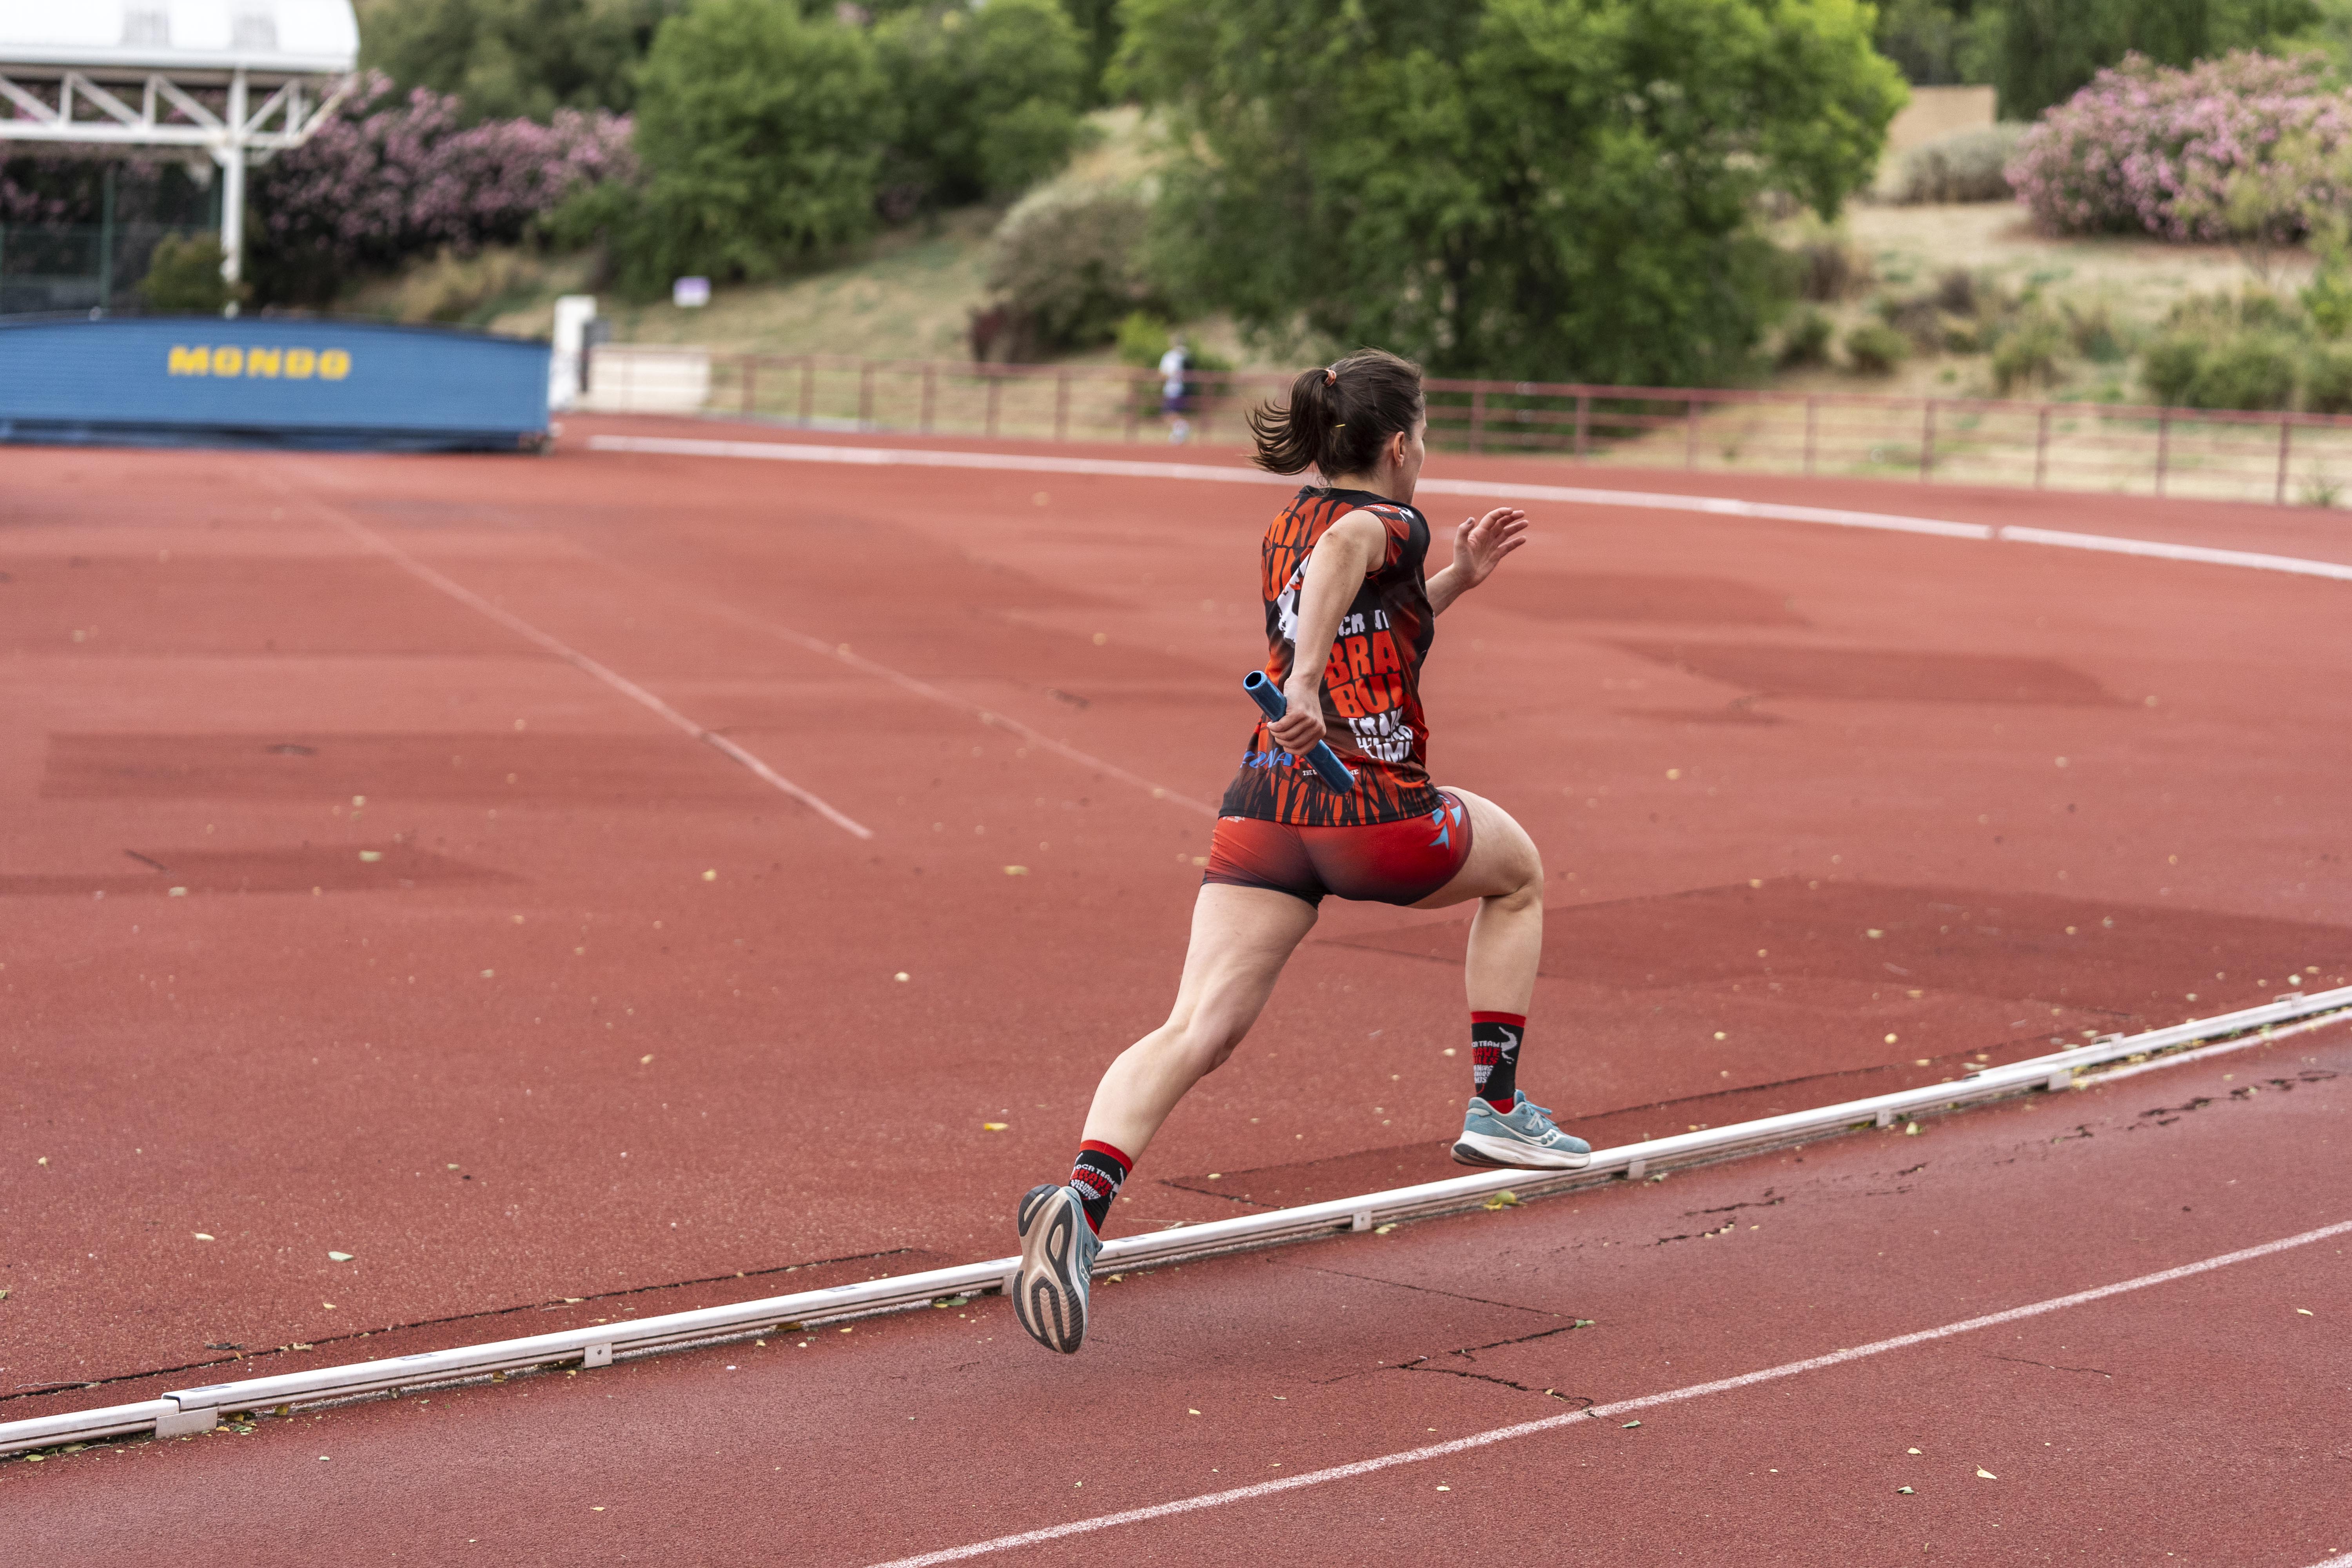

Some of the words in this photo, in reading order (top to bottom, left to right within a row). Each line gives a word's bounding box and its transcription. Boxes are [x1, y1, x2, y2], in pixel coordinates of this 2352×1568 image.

[169, 345, 351, 379] MONDO
[1338, 613, 1365, 636] CR
[1096, 1168, 1115, 1185] TEAM
